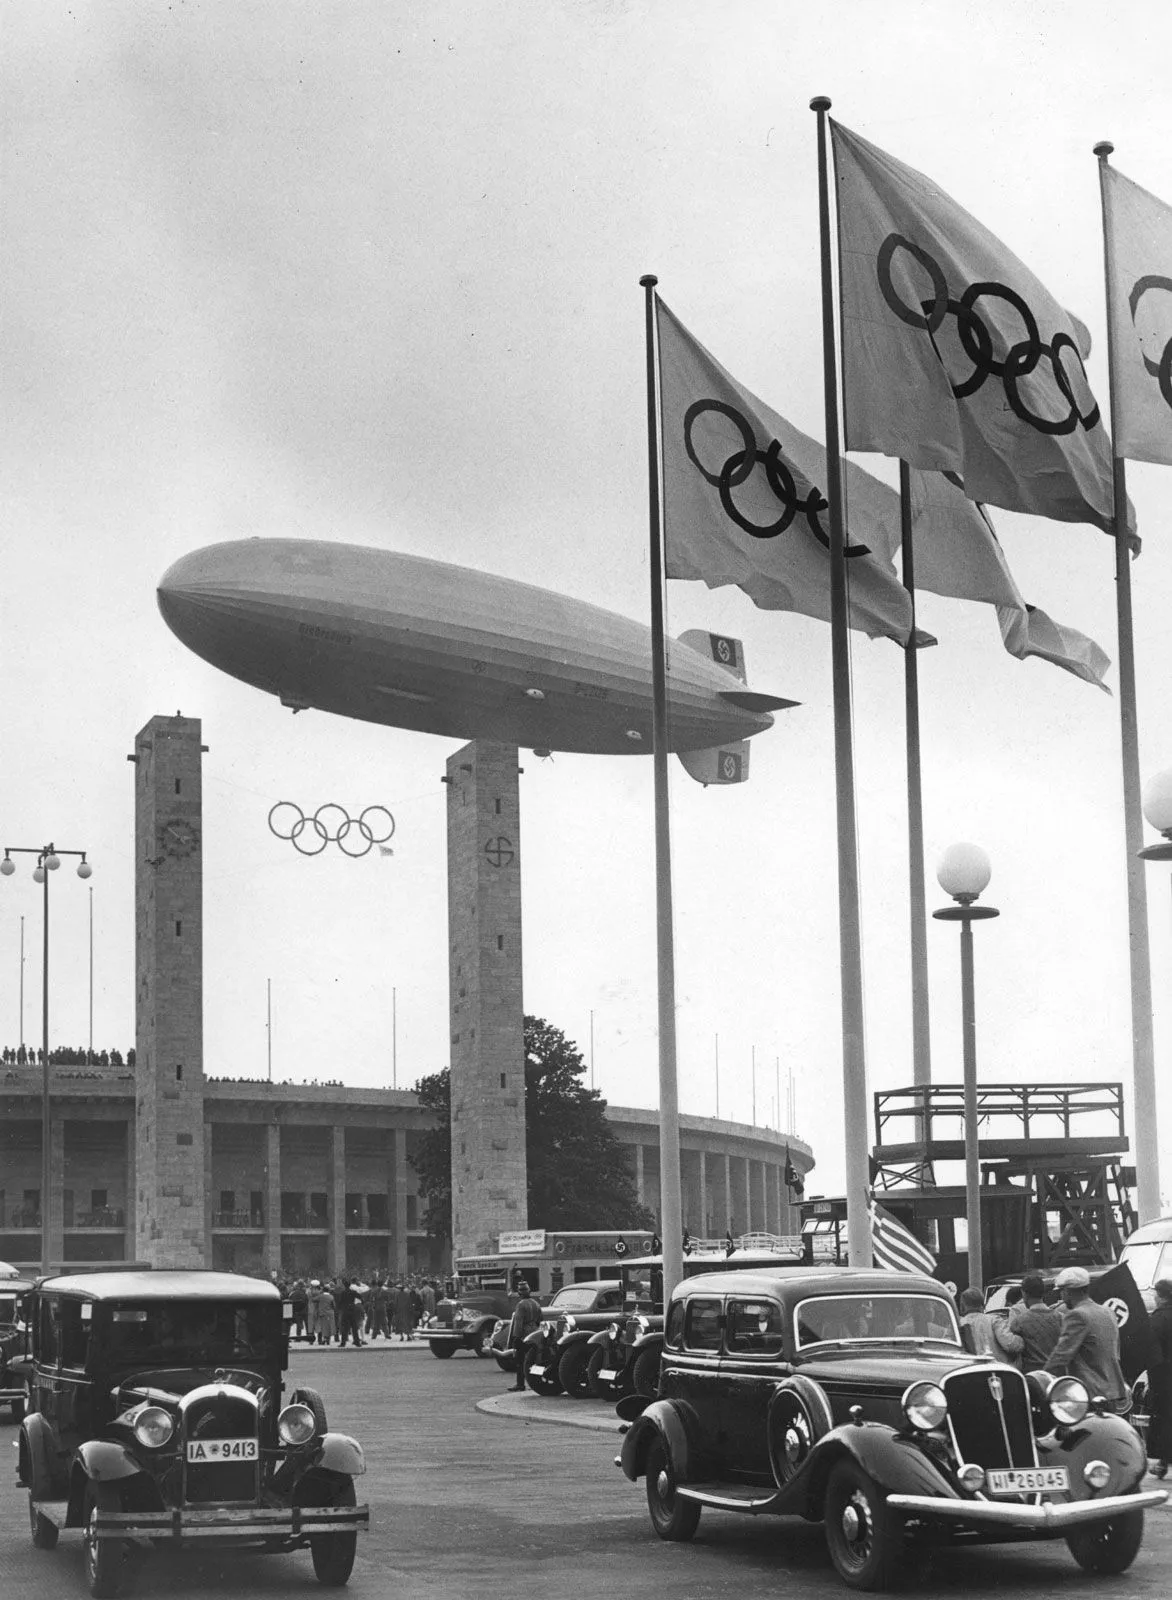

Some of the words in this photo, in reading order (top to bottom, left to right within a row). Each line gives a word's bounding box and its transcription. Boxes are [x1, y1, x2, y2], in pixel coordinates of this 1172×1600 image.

[190, 1443, 207, 1459] IA
[222, 1442, 256, 1457] 9413
[1017, 1472, 1064, 1488] 26045
